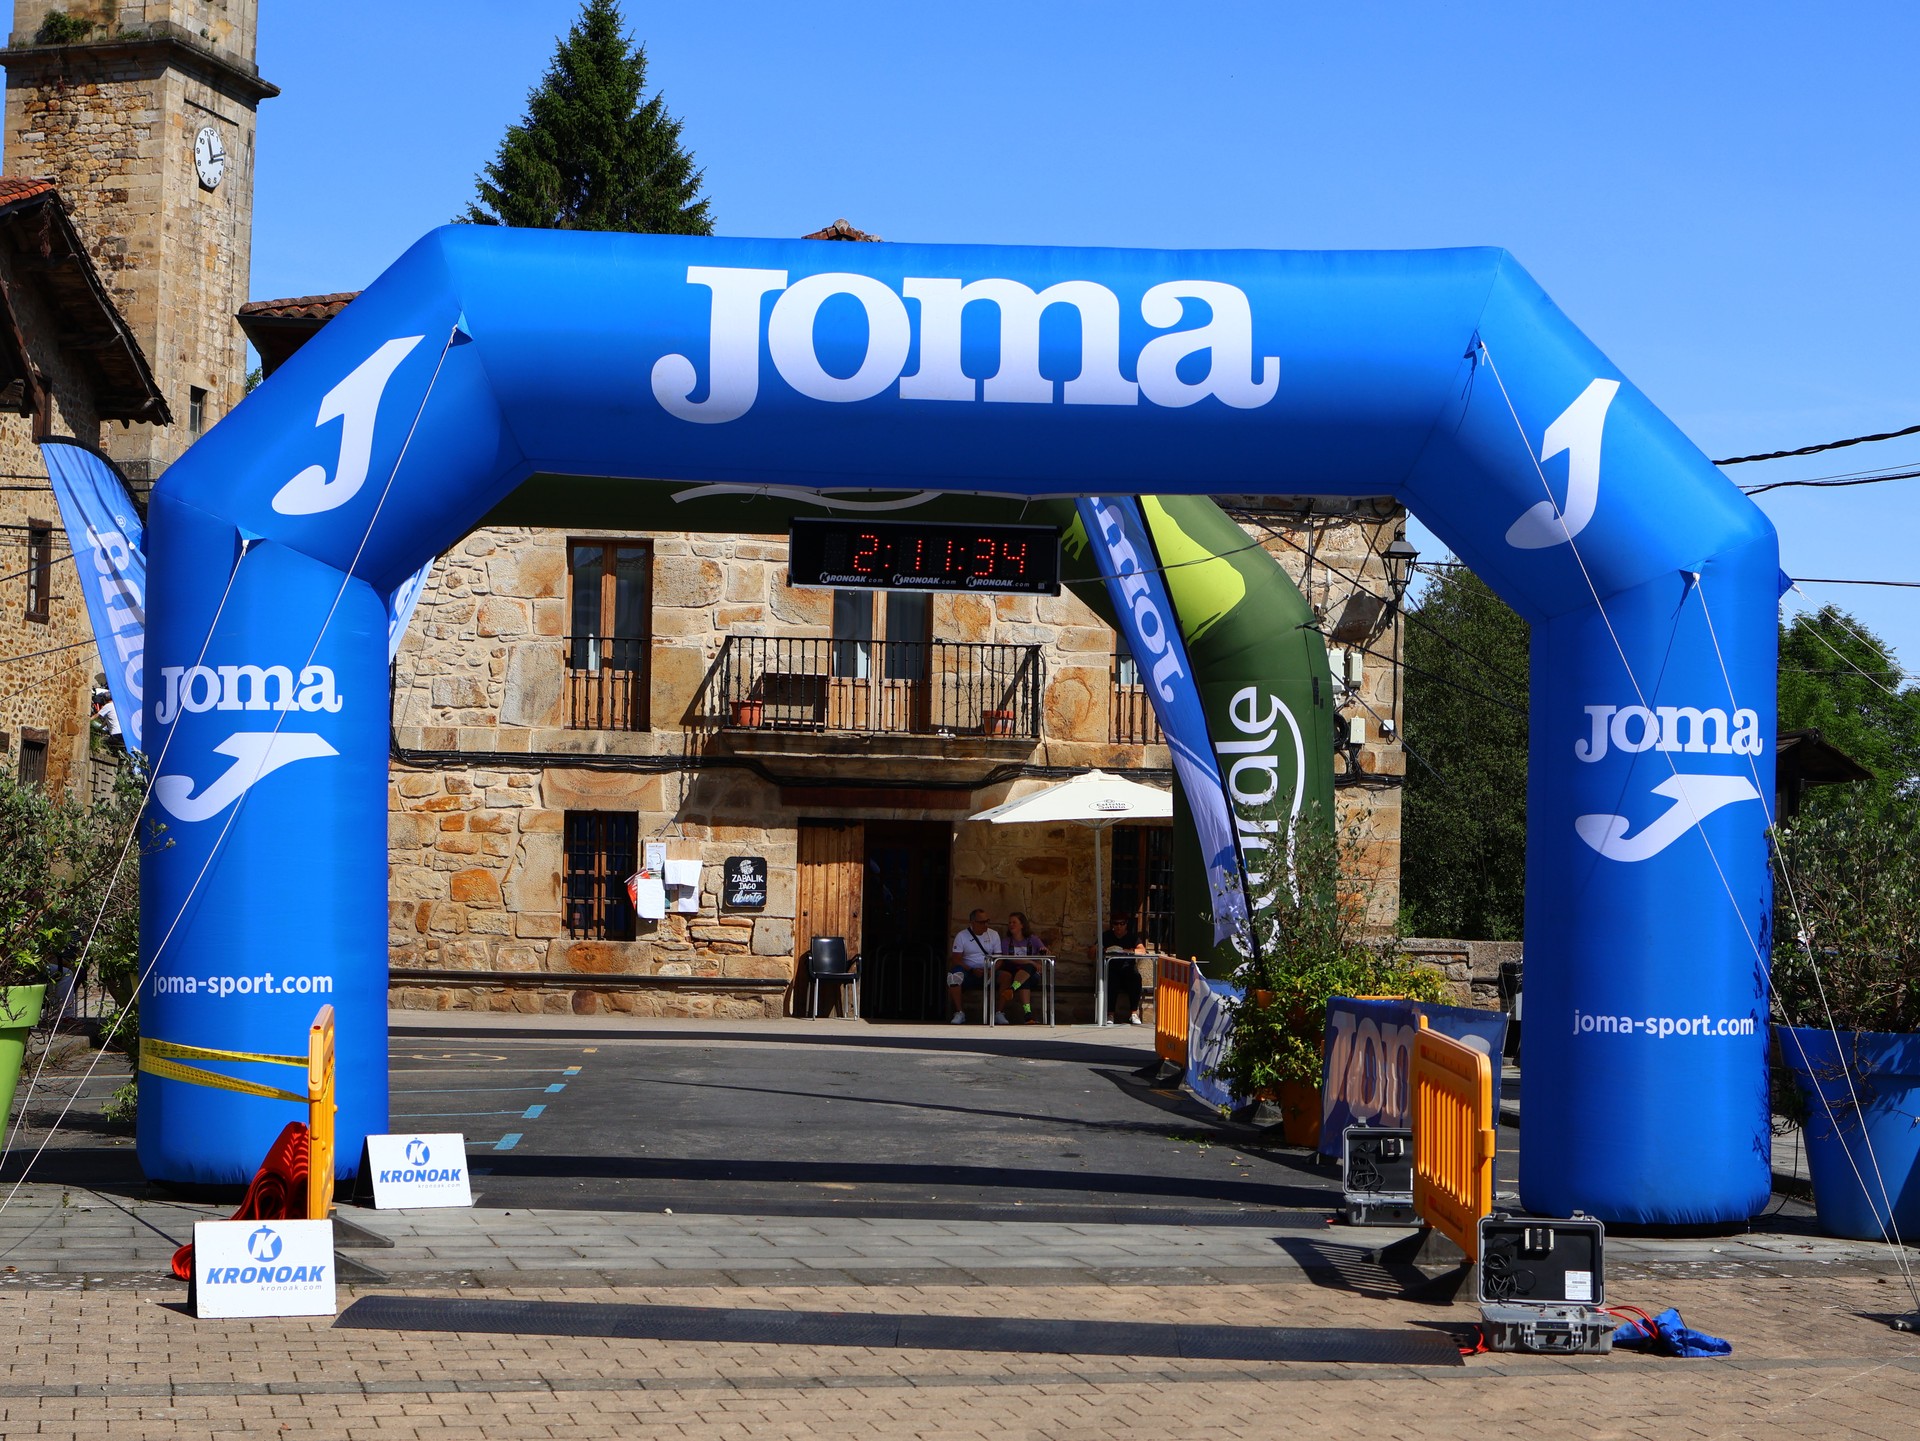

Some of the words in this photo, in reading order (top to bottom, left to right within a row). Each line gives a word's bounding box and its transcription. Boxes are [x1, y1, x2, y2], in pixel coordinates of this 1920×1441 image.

[650, 265, 1281, 424] Joma
[854, 534, 1026, 576] 2:11:34
[155, 665, 343, 725] Joma
[1574, 705, 1763, 763] Joma
[153, 971, 333, 998] joma-sport.com
[1573, 1009, 1754, 1039] joma-sport.com
[379, 1169, 462, 1183] KRONOAK
[206, 1265, 326, 1285] KRONOAK
[260, 1284, 322, 1292] kronoak.com
